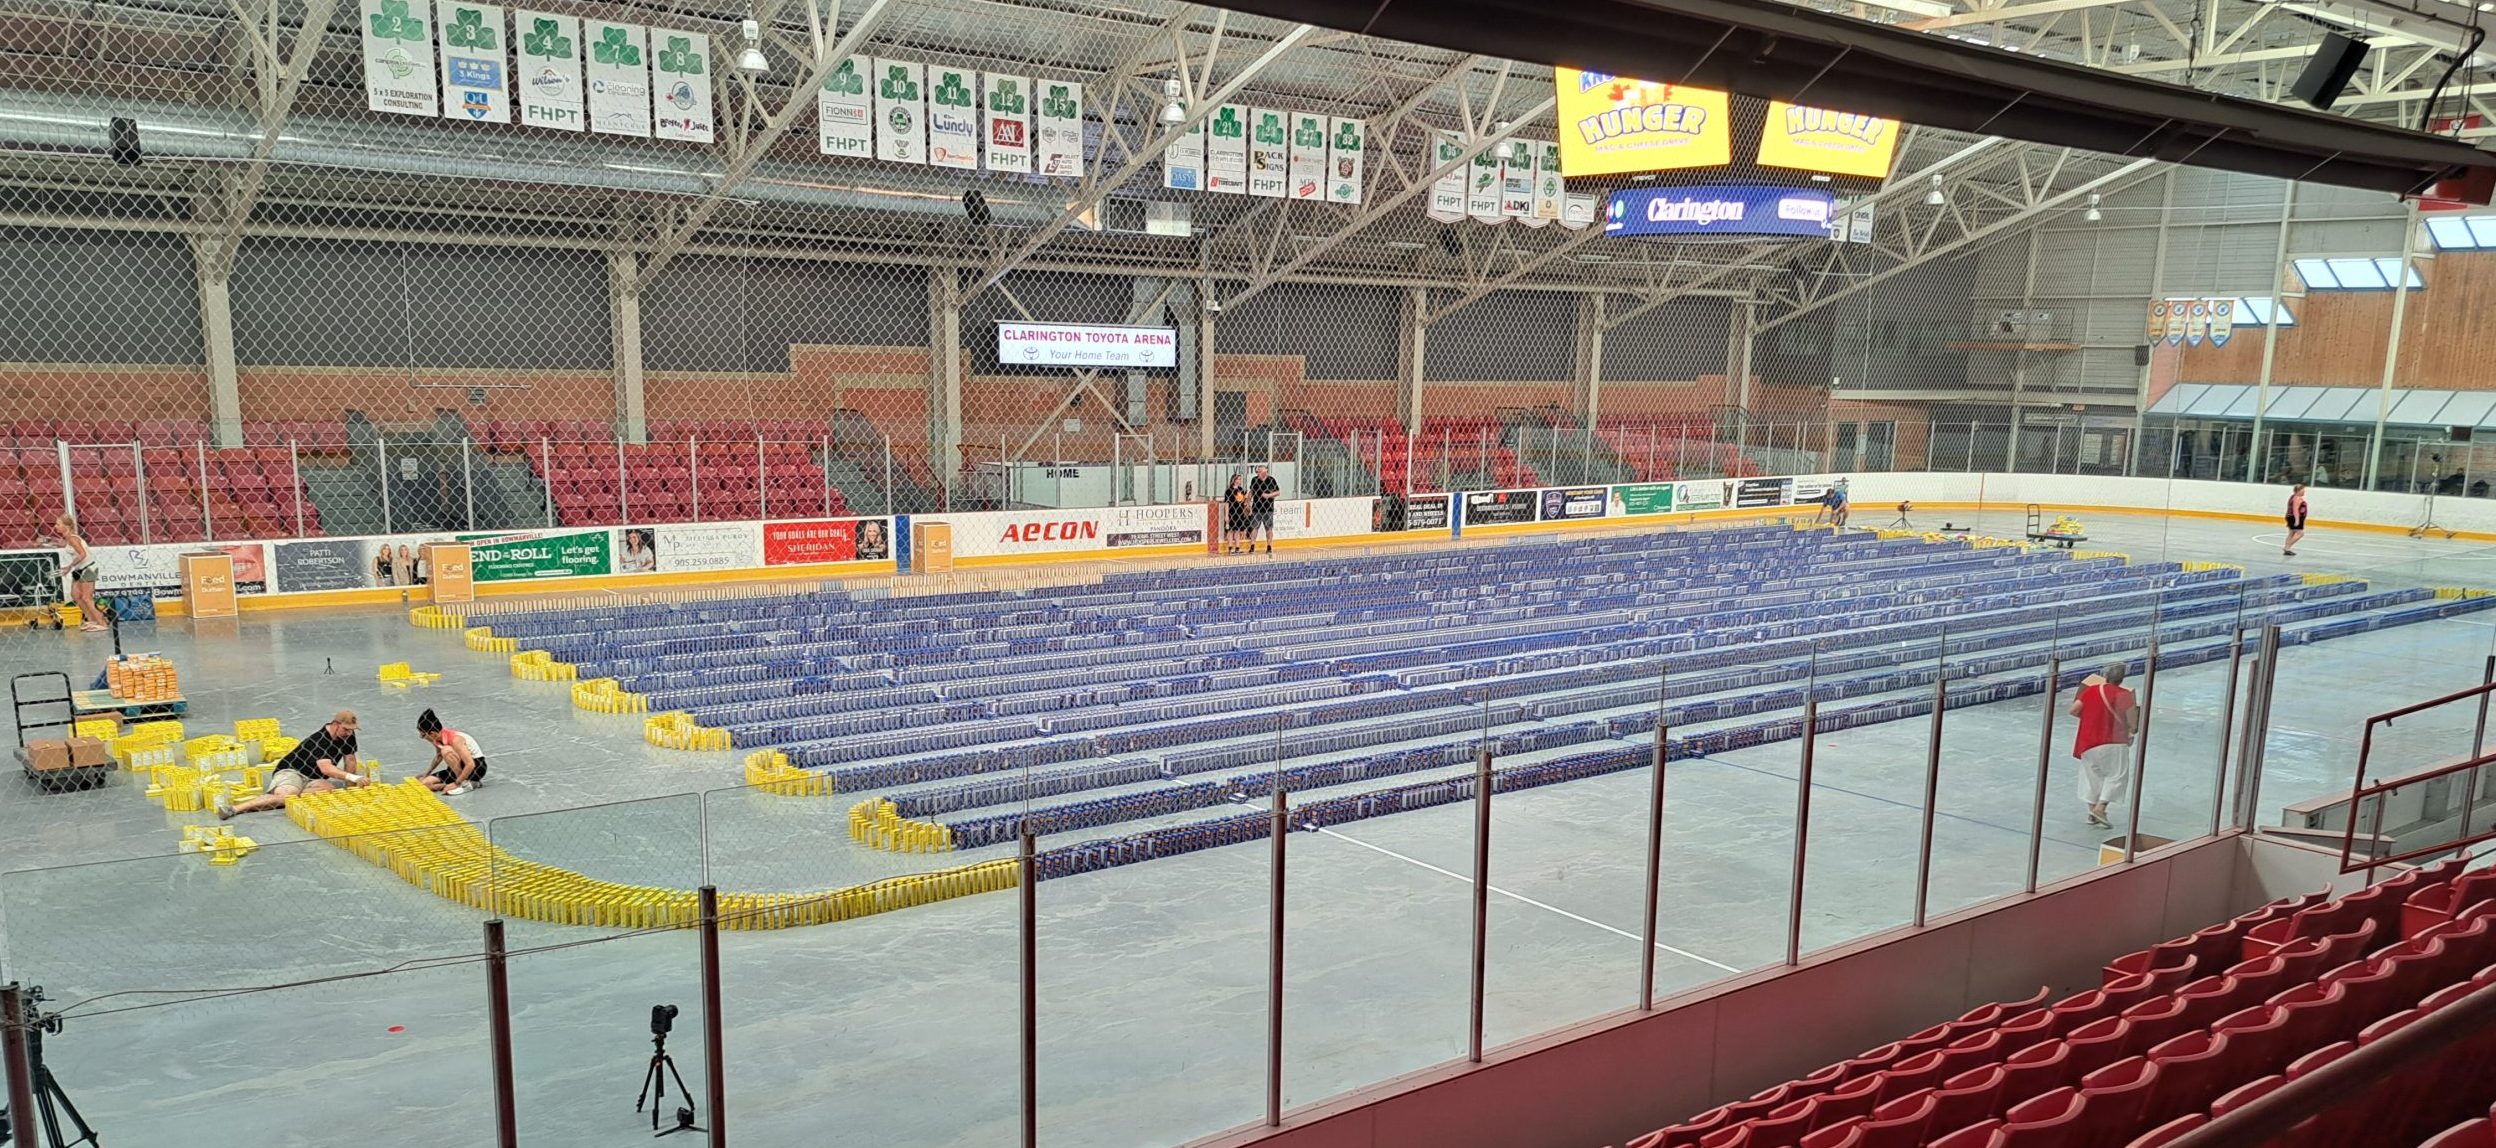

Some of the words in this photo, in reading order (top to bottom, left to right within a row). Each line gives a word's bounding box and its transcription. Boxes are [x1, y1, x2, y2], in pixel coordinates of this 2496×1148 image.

[392, 17, 402, 32] 2
[465, 25, 476, 40] 3
[543, 35, 553, 50] 4
[676, 52, 685, 66] 8
[466, 71, 491, 81] Kings
[839, 73, 847, 85] 9
[892, 79, 906, 93] 10
[390, 90, 433, 101] EXPLORATION
[948, 88, 958, 100] 11
[1001, 93, 1014, 106] 12
[383, 98, 423, 109] CONSULTING
[1053, 98, 1067, 111] 15
[528, 104, 578, 123] FHPT
[933, 114, 973, 137] Lundy
[1222, 121, 1234, 132] 21
[1578, 103, 1707, 145] HUNGER
[1786, 106, 1884, 145] HUNGER
[826, 136, 867, 151] FHPT
[991, 152, 1027, 167] FHPT
[1254, 179, 1284, 191] FHPT
[1437, 194, 1462, 207] FHPT
[1471, 200, 1496, 212] FHPT
[1513, 201, 1530, 211] DKI
[1648, 197, 1744, 226] Clarington
[1786, 204, 1811, 216] Follow
[1004, 329, 1082, 342] CLARINGTON
[1086, 332, 1129, 343] TOYOTA
[1134, 334, 1172, 345] ARENA
[1049, 349, 1072, 360] Your
[1075, 350, 1103, 360] Home
[1106, 350, 1129, 361] Team
[1046, 468, 1080, 479] HOME
[1136, 507, 1194, 519] HOOPERS
[1280, 505, 1302, 515] team
[787, 530, 806, 540] GOALS
[807, 529, 817, 539] ARE
[817, 529, 829, 538] OUR
[309, 549, 331, 557] PATTI
[510, 547, 552, 561] ROLL
[561, 545, 582, 555] Let's
[584, 545, 600, 556] get
[787, 543, 836, 553] SHERIDAN
[297, 556, 346, 567] ROBERTSON
[562, 555, 600, 568] flooring.
[102, 572, 182, 583] BOWMANVILLE
